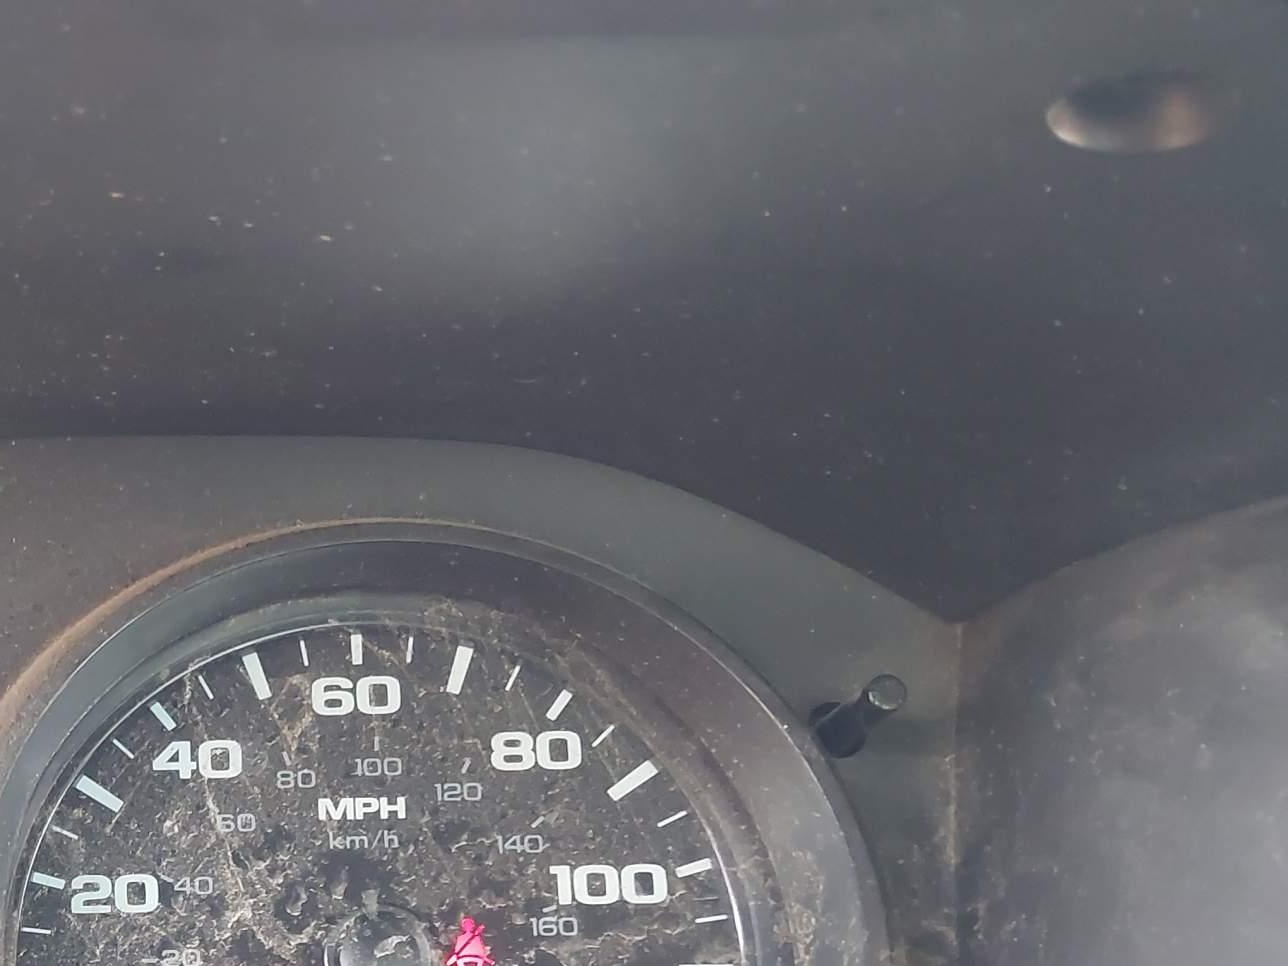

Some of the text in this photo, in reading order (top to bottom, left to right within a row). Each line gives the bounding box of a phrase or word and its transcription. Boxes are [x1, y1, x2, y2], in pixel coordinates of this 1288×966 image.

[312, 676, 401, 717] 60
[152, 740, 243, 781] 40
[490, 730, 583, 771] 80
[354, 757, 402, 777] 100
[276, 769, 316, 789] 80
[434, 782, 483, 802] 120
[317, 796, 407, 821] MPH
[329, 829, 400, 850] km/h
[497, 834, 544, 854] 140
[70, 874, 160, 914] 20
[174, 876, 213, 895] 40
[549, 864, 669, 906] 100
[529, 916, 579, 937] 160
